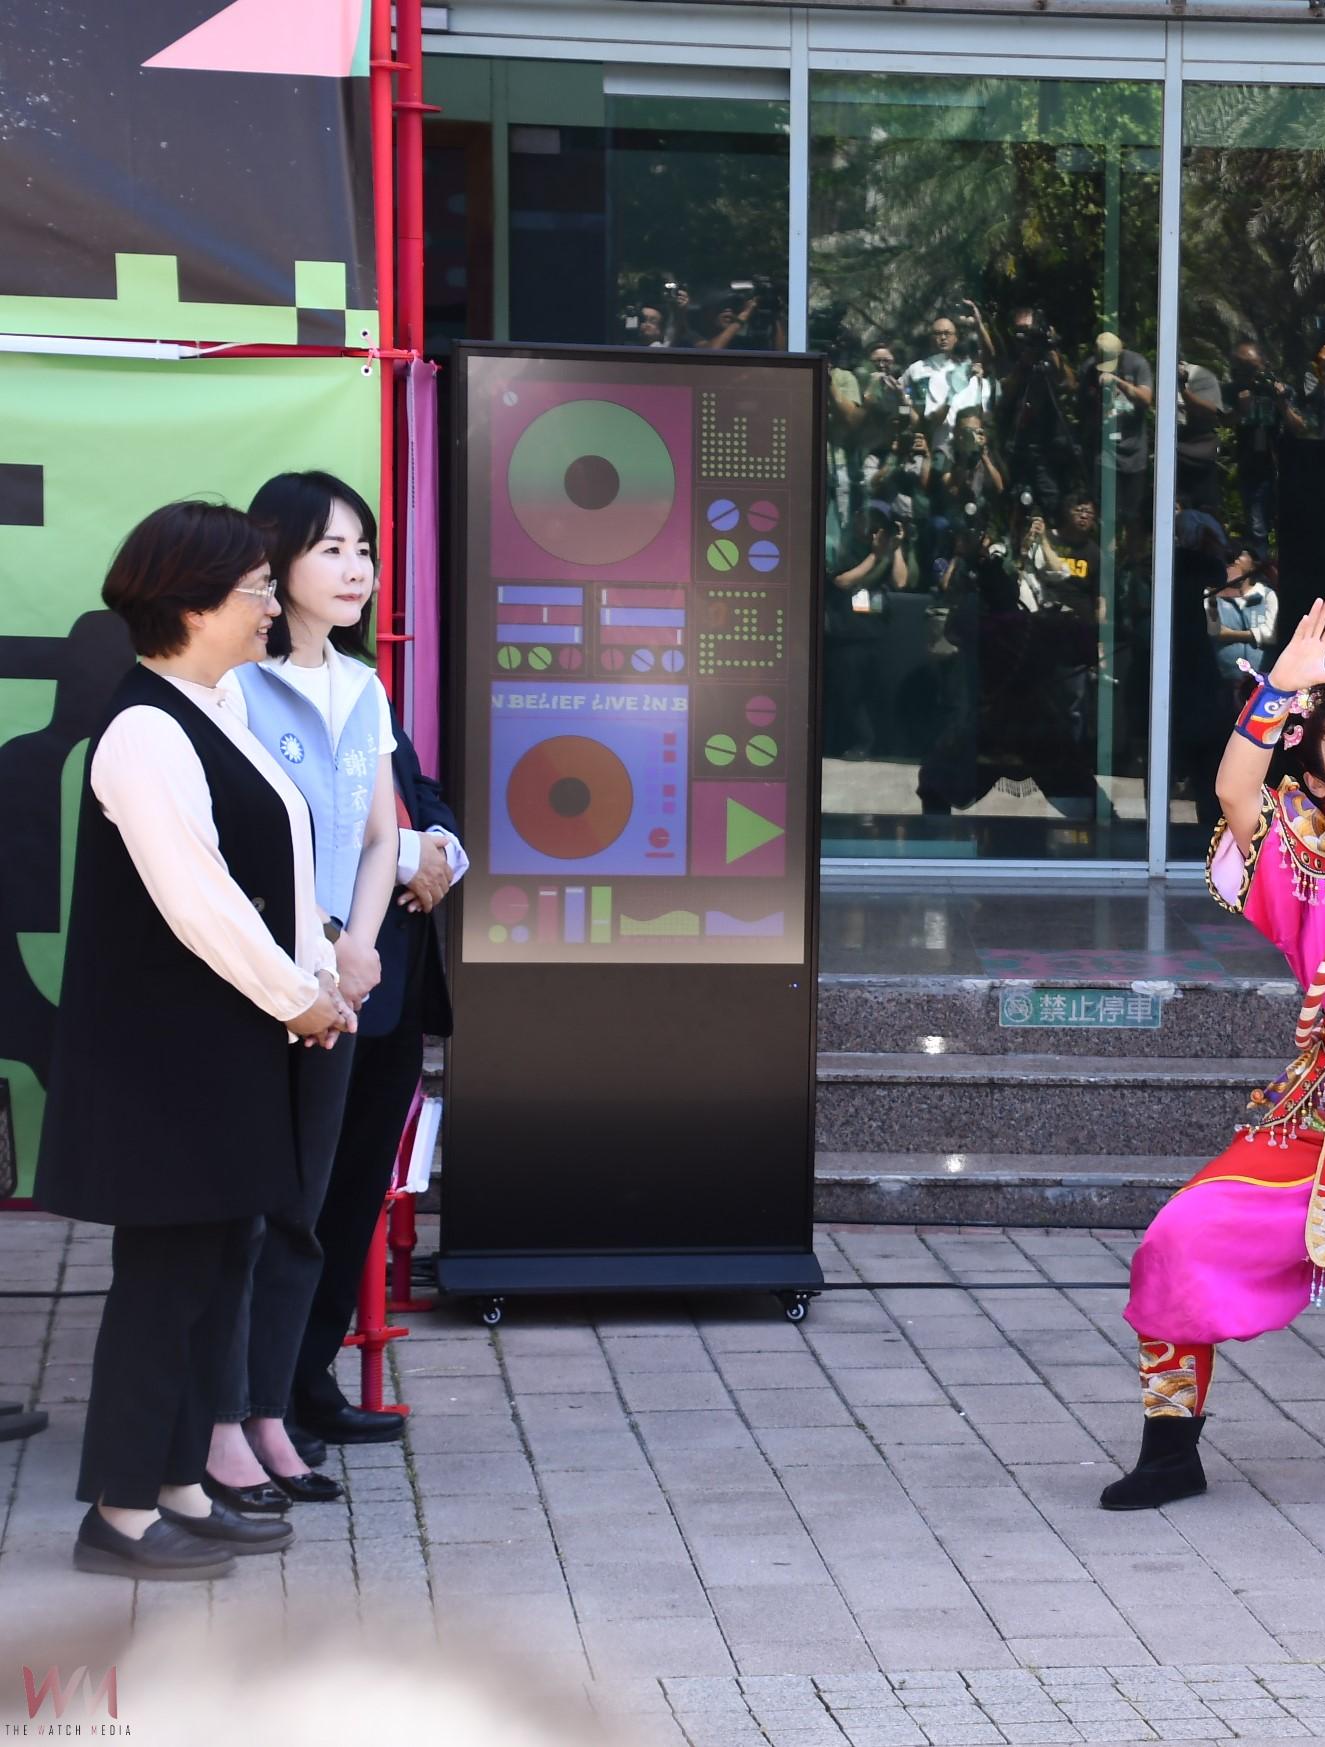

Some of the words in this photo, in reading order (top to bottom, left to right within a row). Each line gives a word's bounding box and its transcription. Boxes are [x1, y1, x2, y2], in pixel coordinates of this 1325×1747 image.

[507, 692, 586, 710] BELIEF
[592, 693, 639, 711] LIVE
[1039, 994, 1153, 1024] 禁止停車
